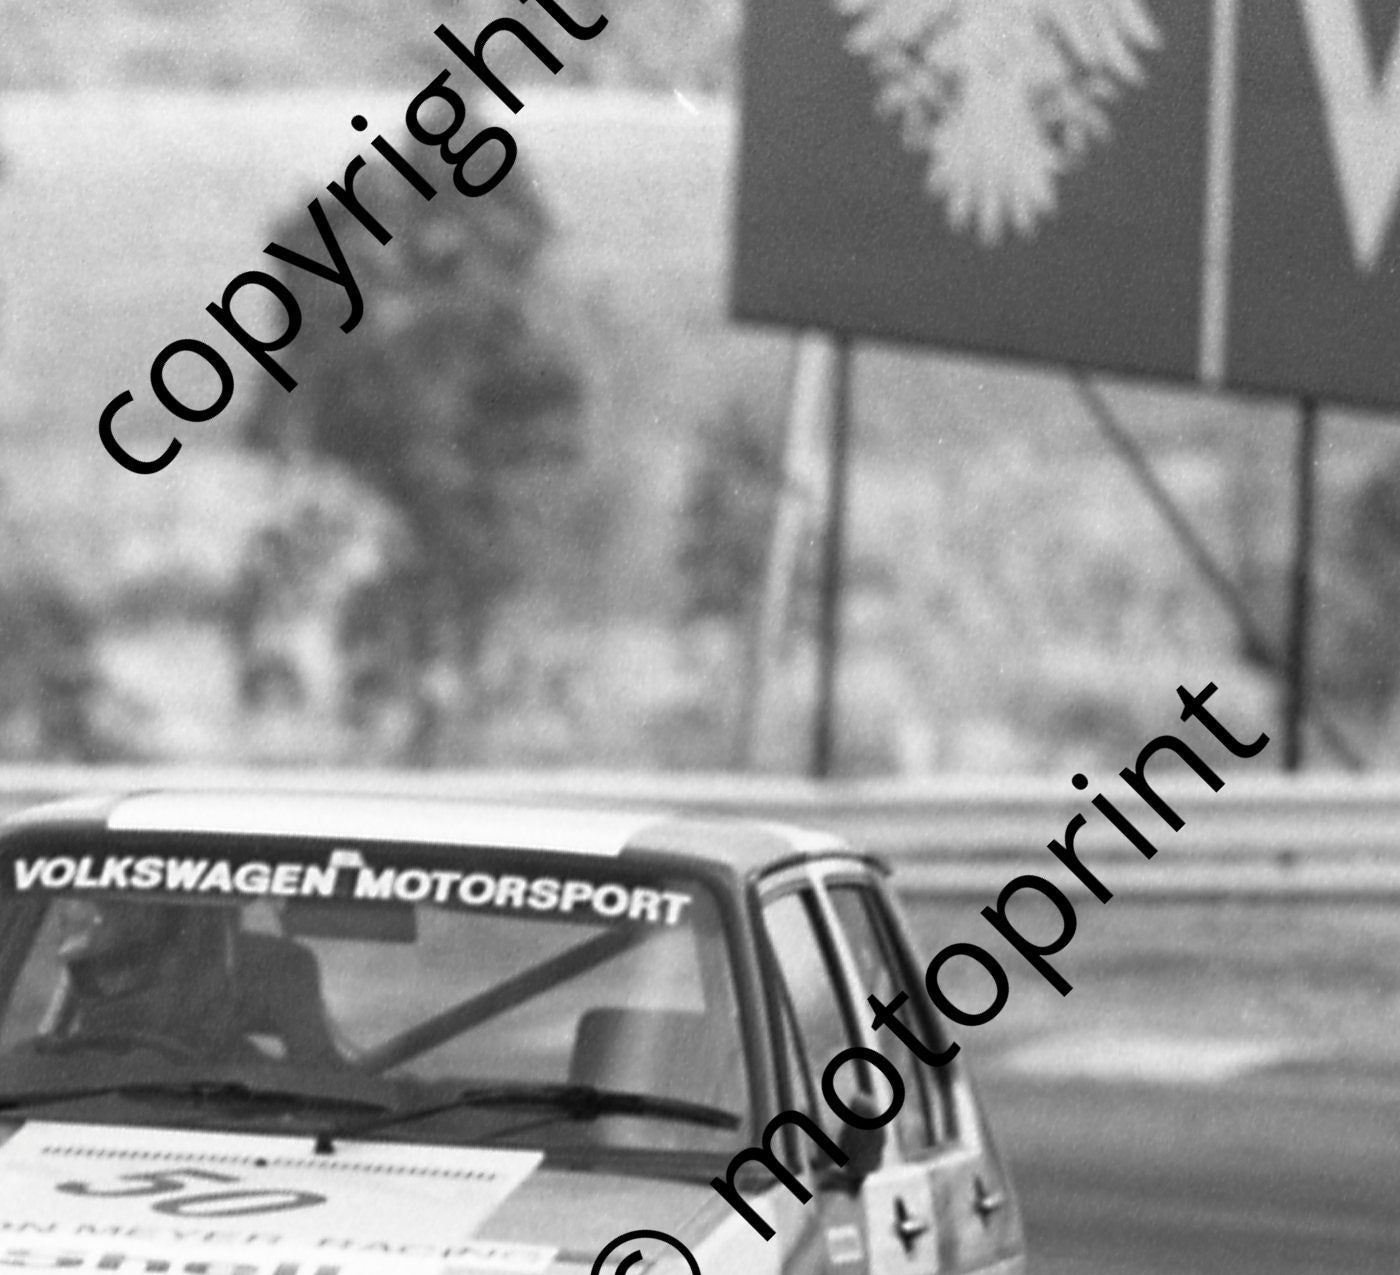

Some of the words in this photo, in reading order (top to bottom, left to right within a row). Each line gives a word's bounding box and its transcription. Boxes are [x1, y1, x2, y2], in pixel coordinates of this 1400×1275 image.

[14, 856, 336, 897] VOLKSWAGEN
[353, 868, 691, 926] MOTORSPORT
[56, 1168, 328, 1218] 50
